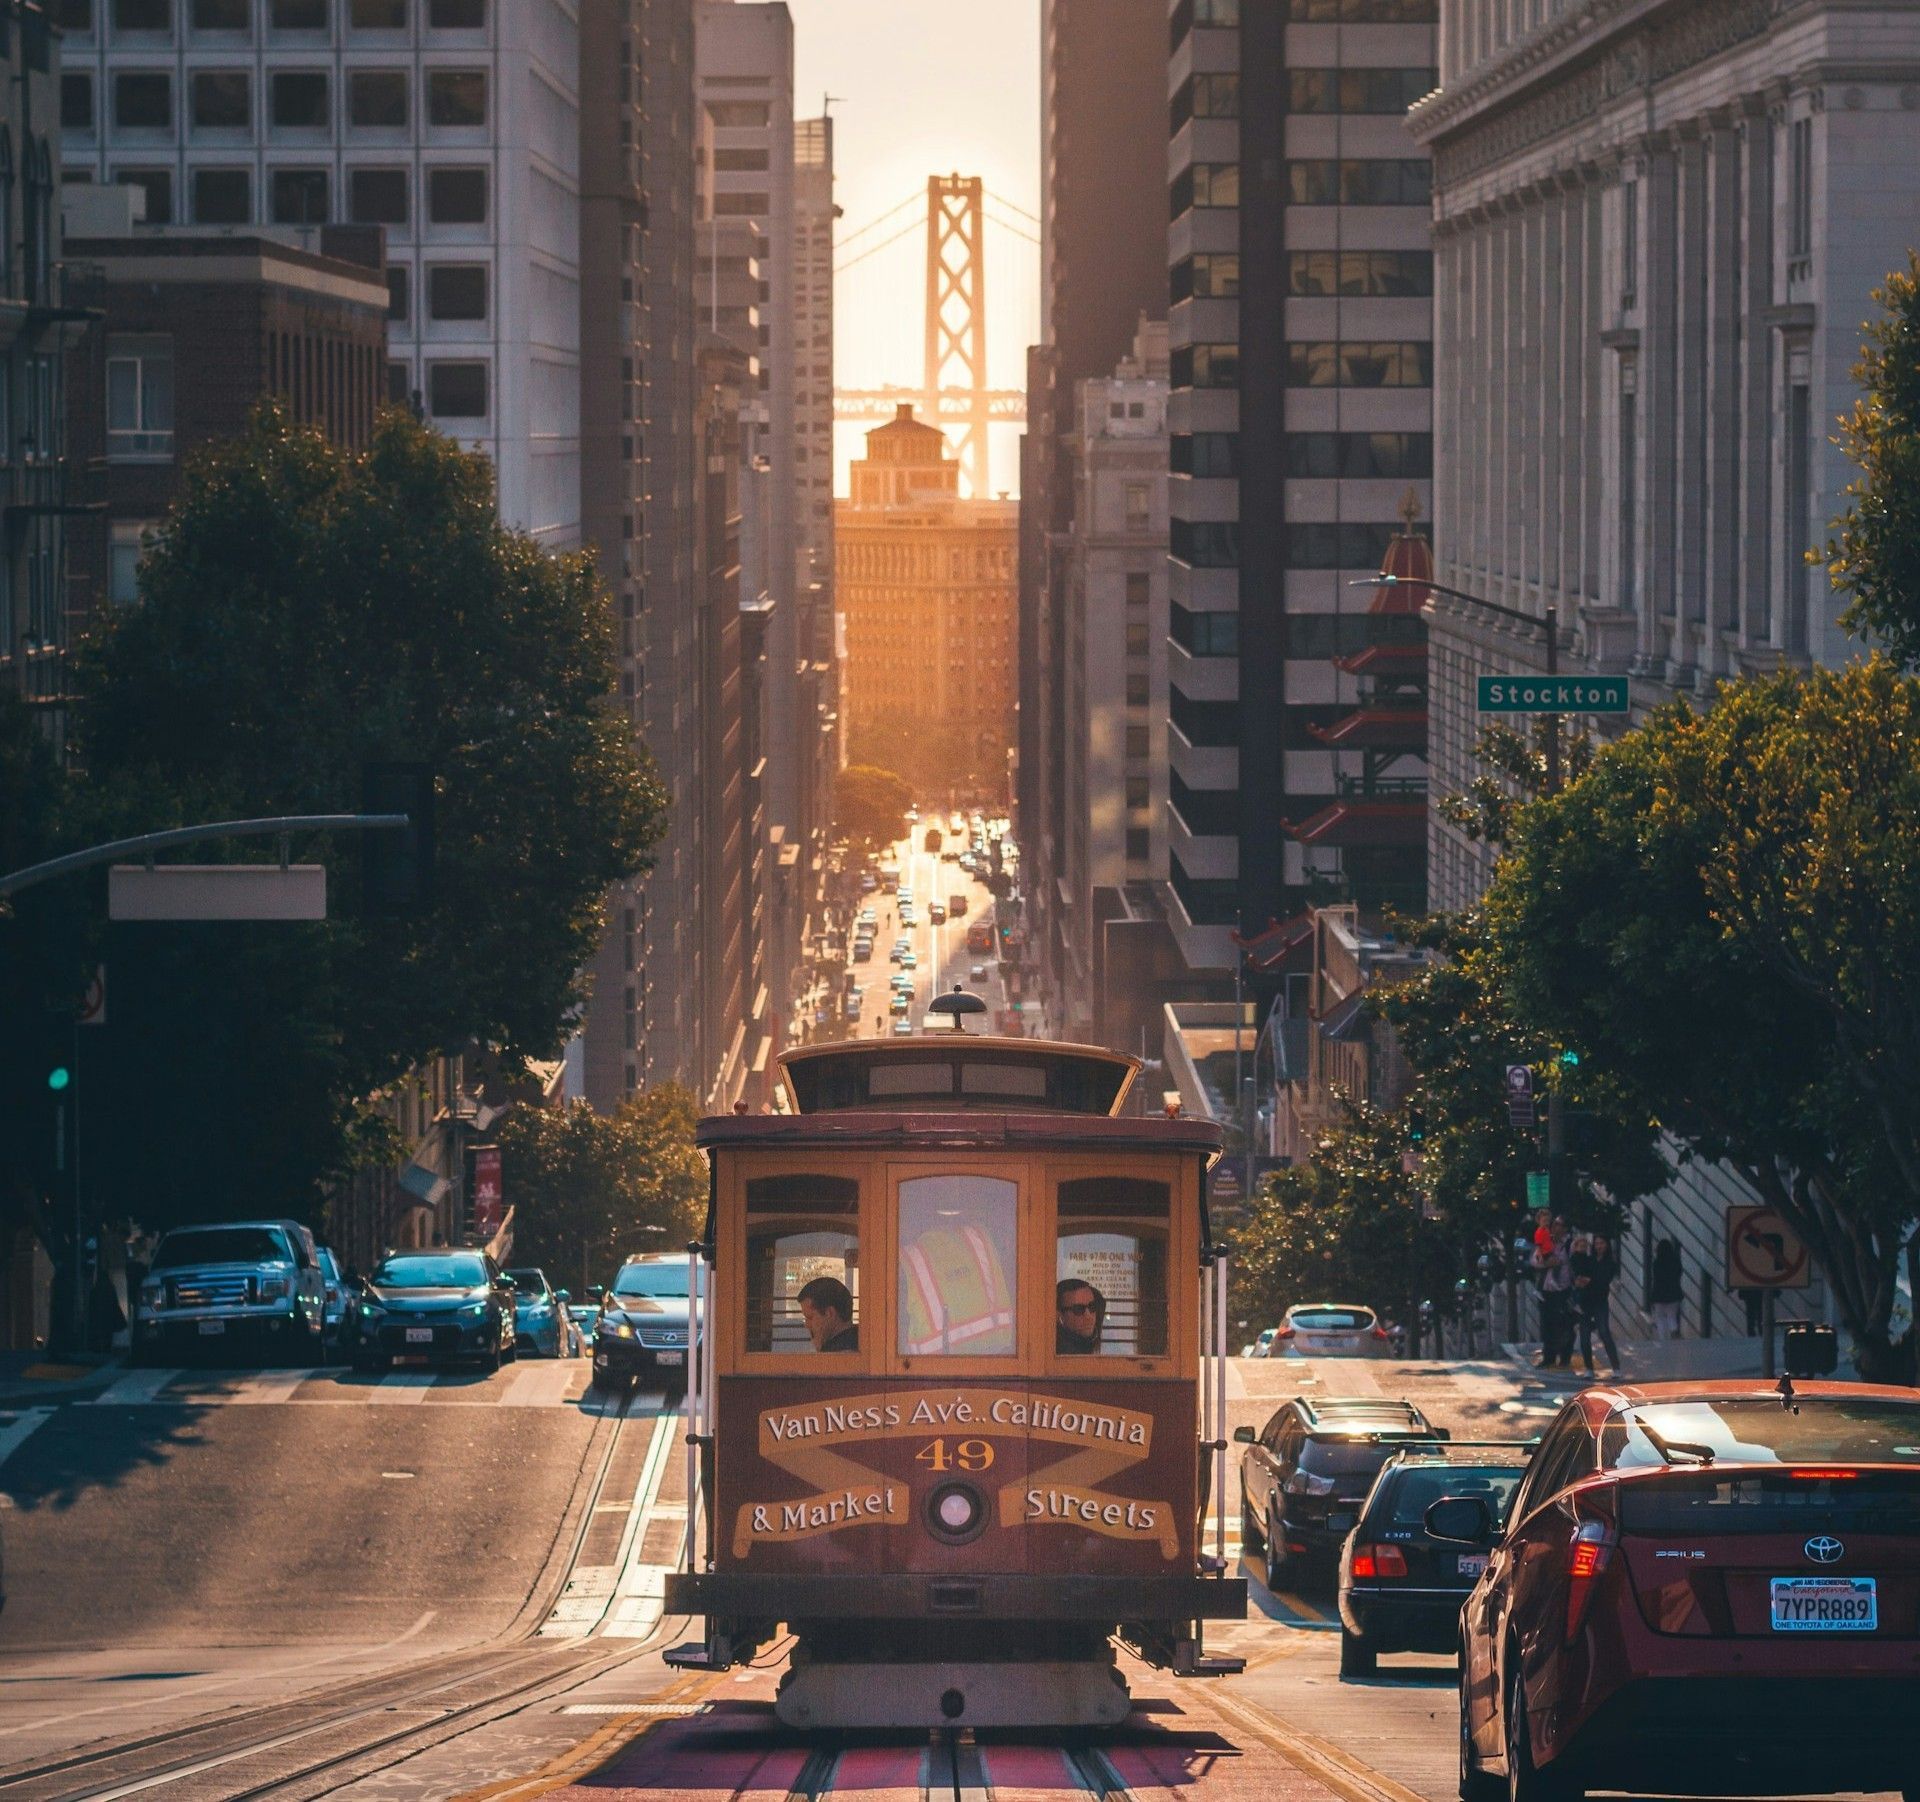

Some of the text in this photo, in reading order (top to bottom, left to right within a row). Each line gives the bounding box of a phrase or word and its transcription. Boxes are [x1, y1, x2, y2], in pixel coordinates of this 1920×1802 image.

[1489, 684, 1618, 704] Stockton
[1069, 1252, 1087, 1261] FARE
[1109, 1252, 1124, 1261] ONE
[767, 1414, 819, 1440] Van
[824, 1405, 901, 1432] Ness
[991, 1398, 1146, 1446] California
[915, 1438, 995, 1472] 49
[753, 1488, 895, 1532] & Market
[1026, 1489, 1156, 1530] Streets
[1656, 1551, 1705, 1559] PRIUS
[1779, 1599, 1868, 1620] 7YPR889
